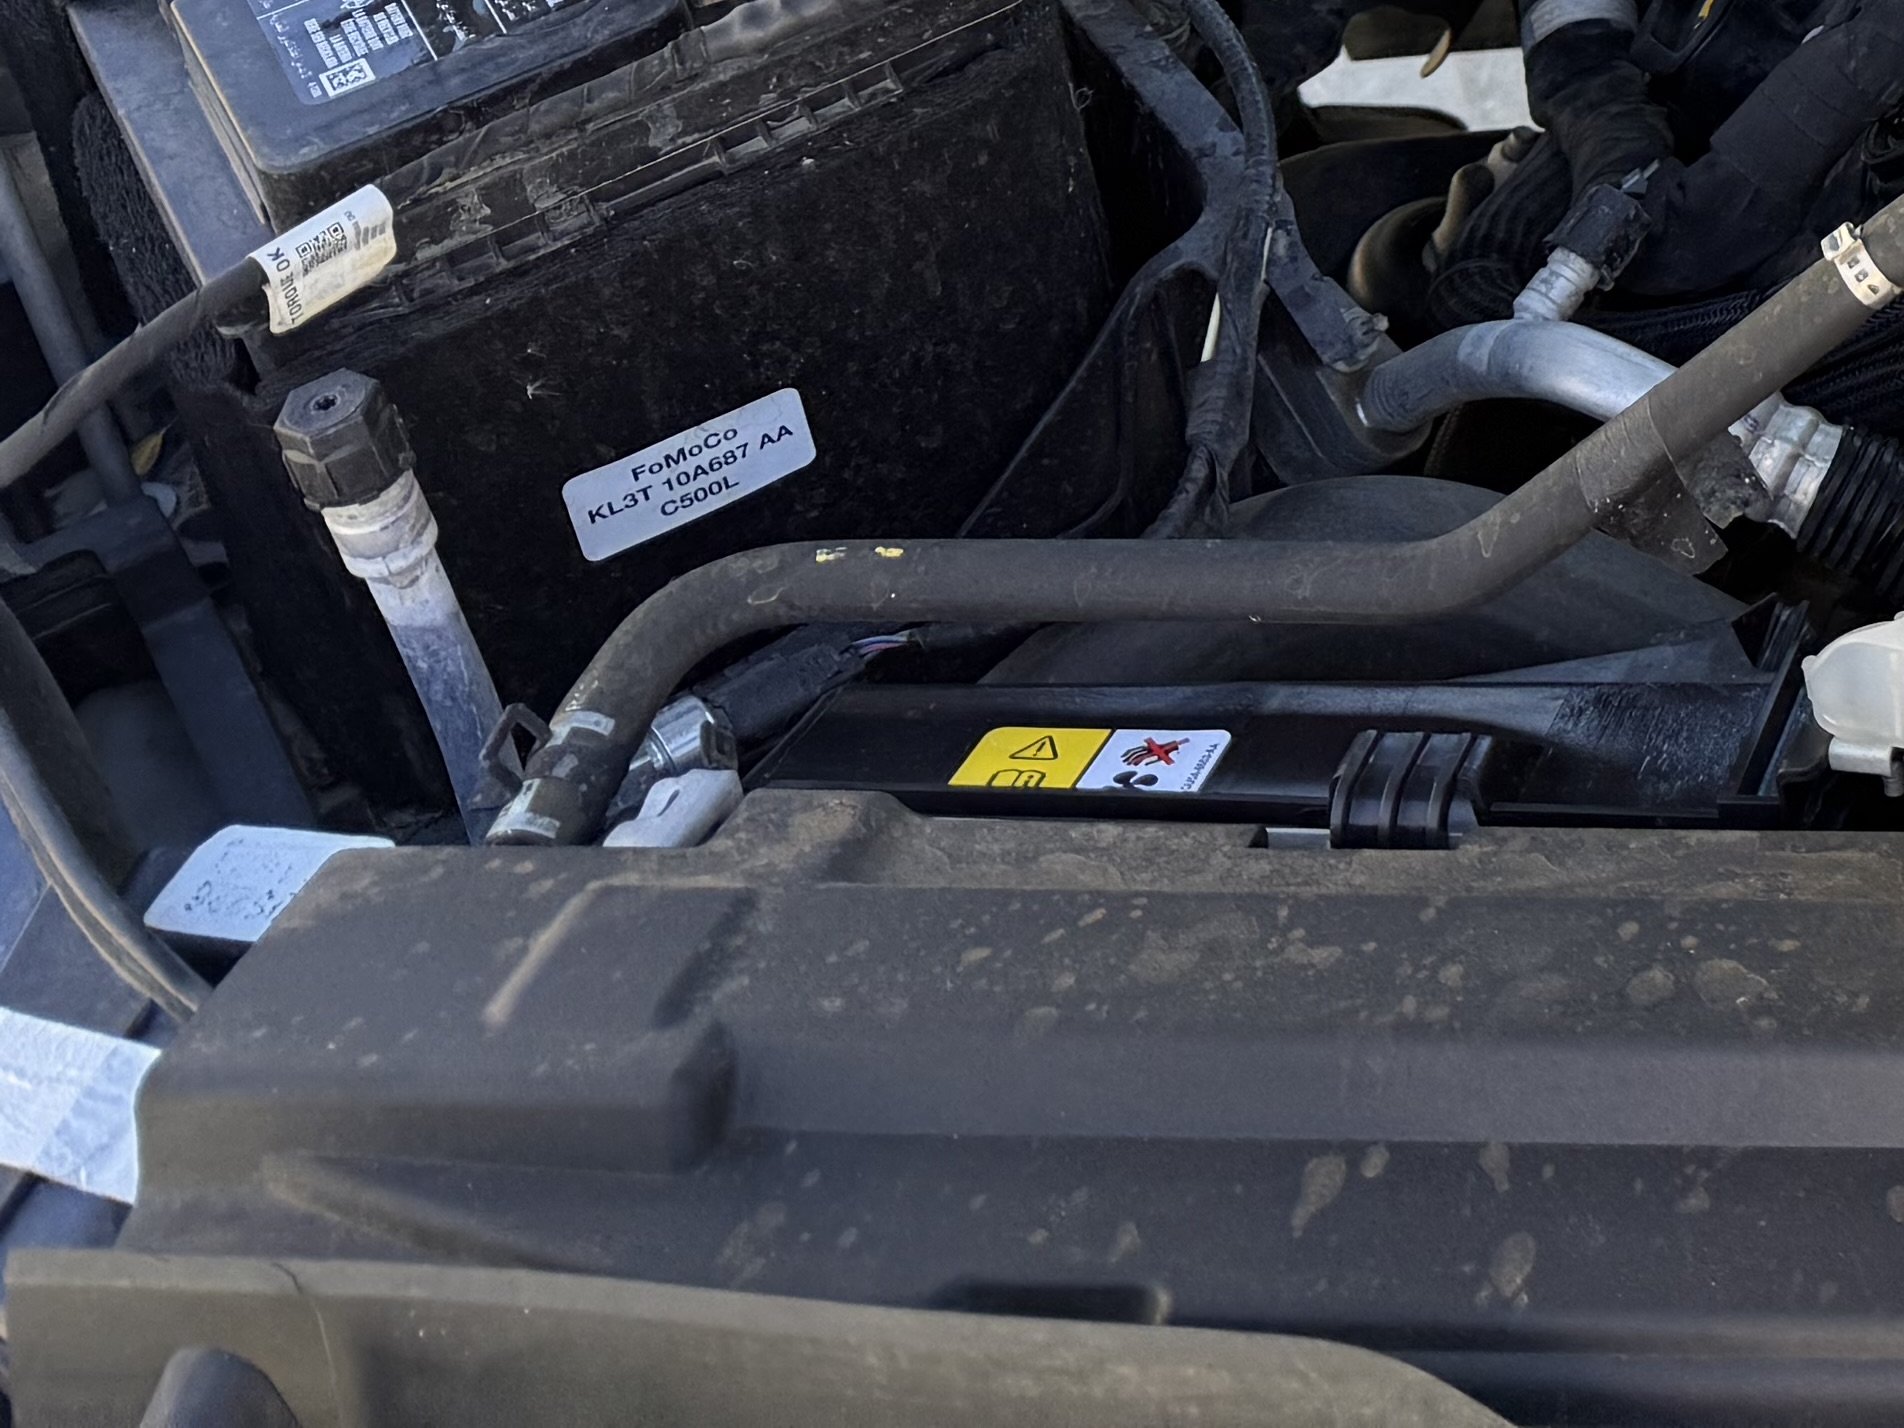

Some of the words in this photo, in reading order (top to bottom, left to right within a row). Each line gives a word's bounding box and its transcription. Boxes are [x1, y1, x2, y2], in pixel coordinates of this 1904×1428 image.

[266, 246, 291, 272] OK
[587, 485, 653, 524] KL3T
[661, 442, 749, 492] 10A687
[758, 425, 793, 450] AA
[631, 428, 738, 482] FoMoCo
[660, 475, 740, 517] C500L
